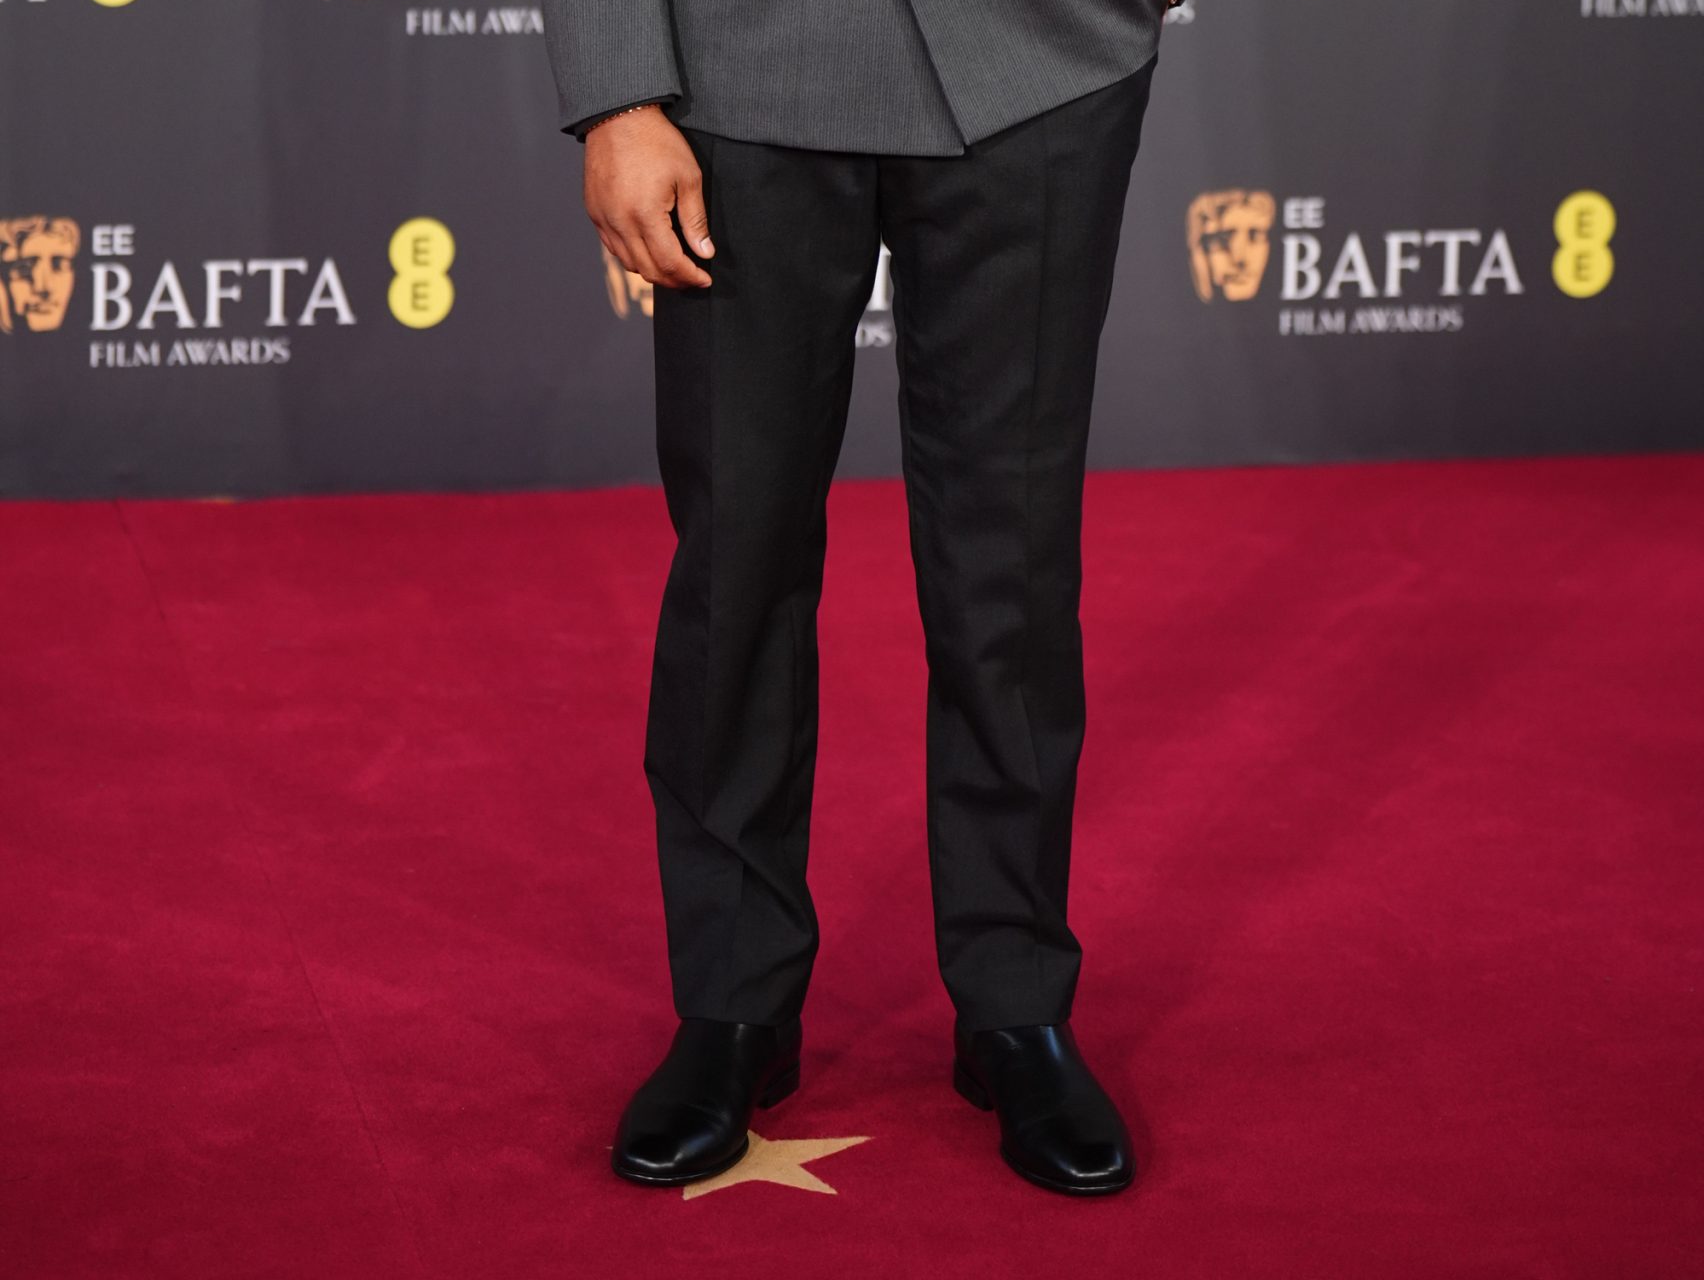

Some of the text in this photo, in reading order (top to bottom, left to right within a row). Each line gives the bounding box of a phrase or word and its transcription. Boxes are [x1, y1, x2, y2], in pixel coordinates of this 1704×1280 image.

[406, 9, 476, 35] FILM
[1283, 197, 1324, 229] EE
[92, 225, 134, 256] EE
[1281, 229, 1522, 300] BAFTA
[91, 258, 355, 331] BAFTA
[89, 338, 290, 368] FILM AWARDS
